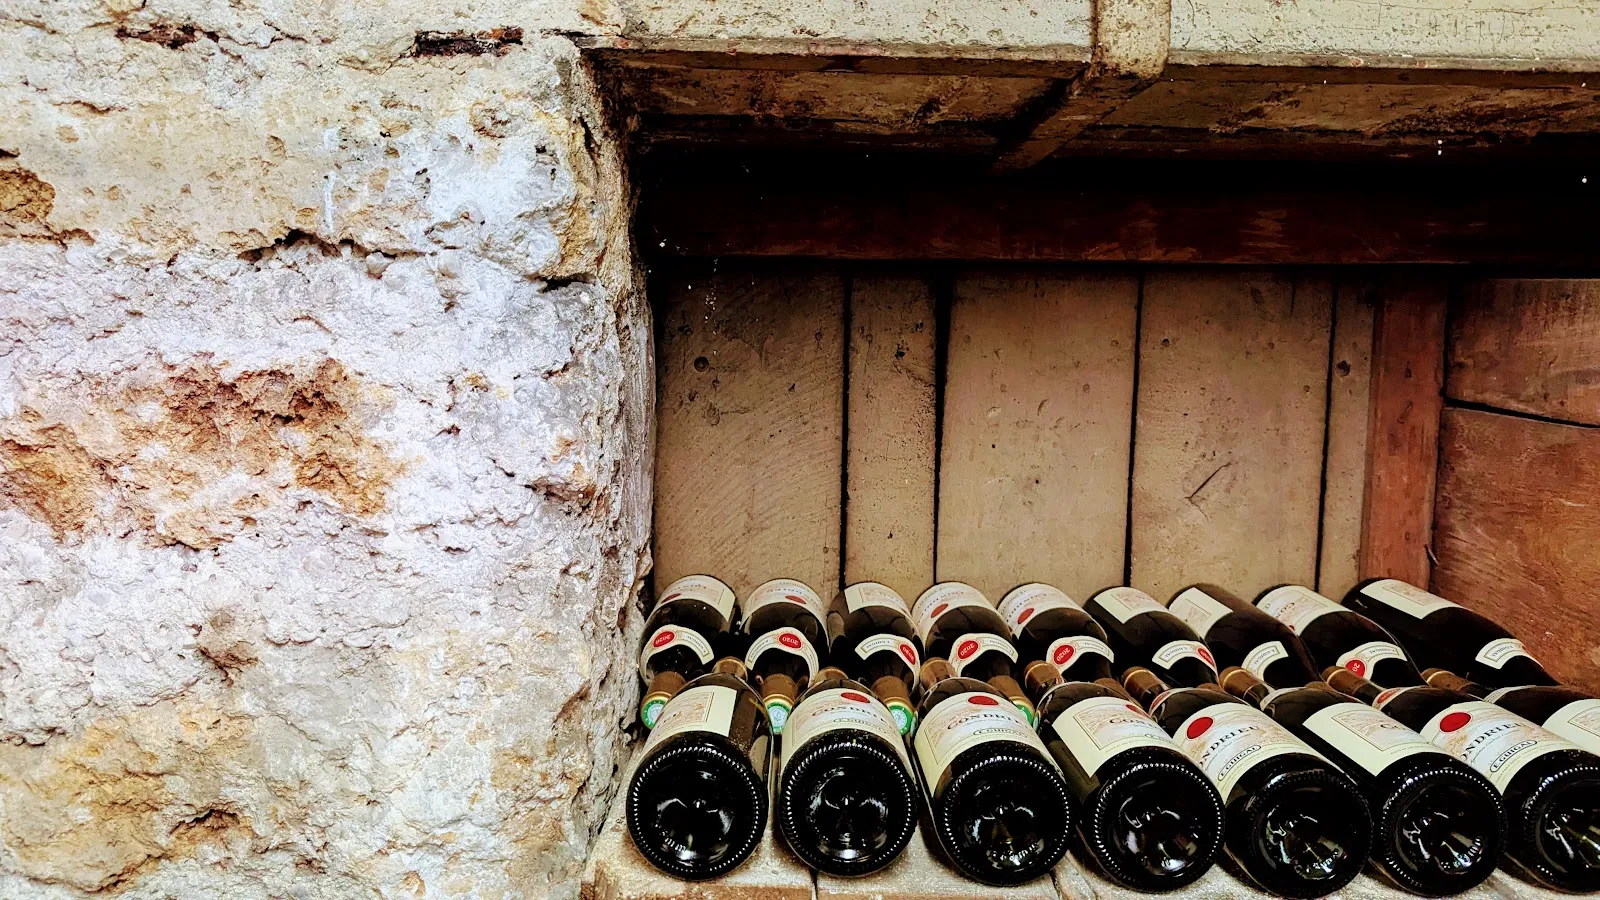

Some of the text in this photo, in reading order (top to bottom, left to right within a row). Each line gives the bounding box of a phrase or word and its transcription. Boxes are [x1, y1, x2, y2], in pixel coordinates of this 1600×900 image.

[782, 636, 798, 645] 2020
[960, 643, 974, 656] 2020
[1056, 648, 1071, 662] 2020
